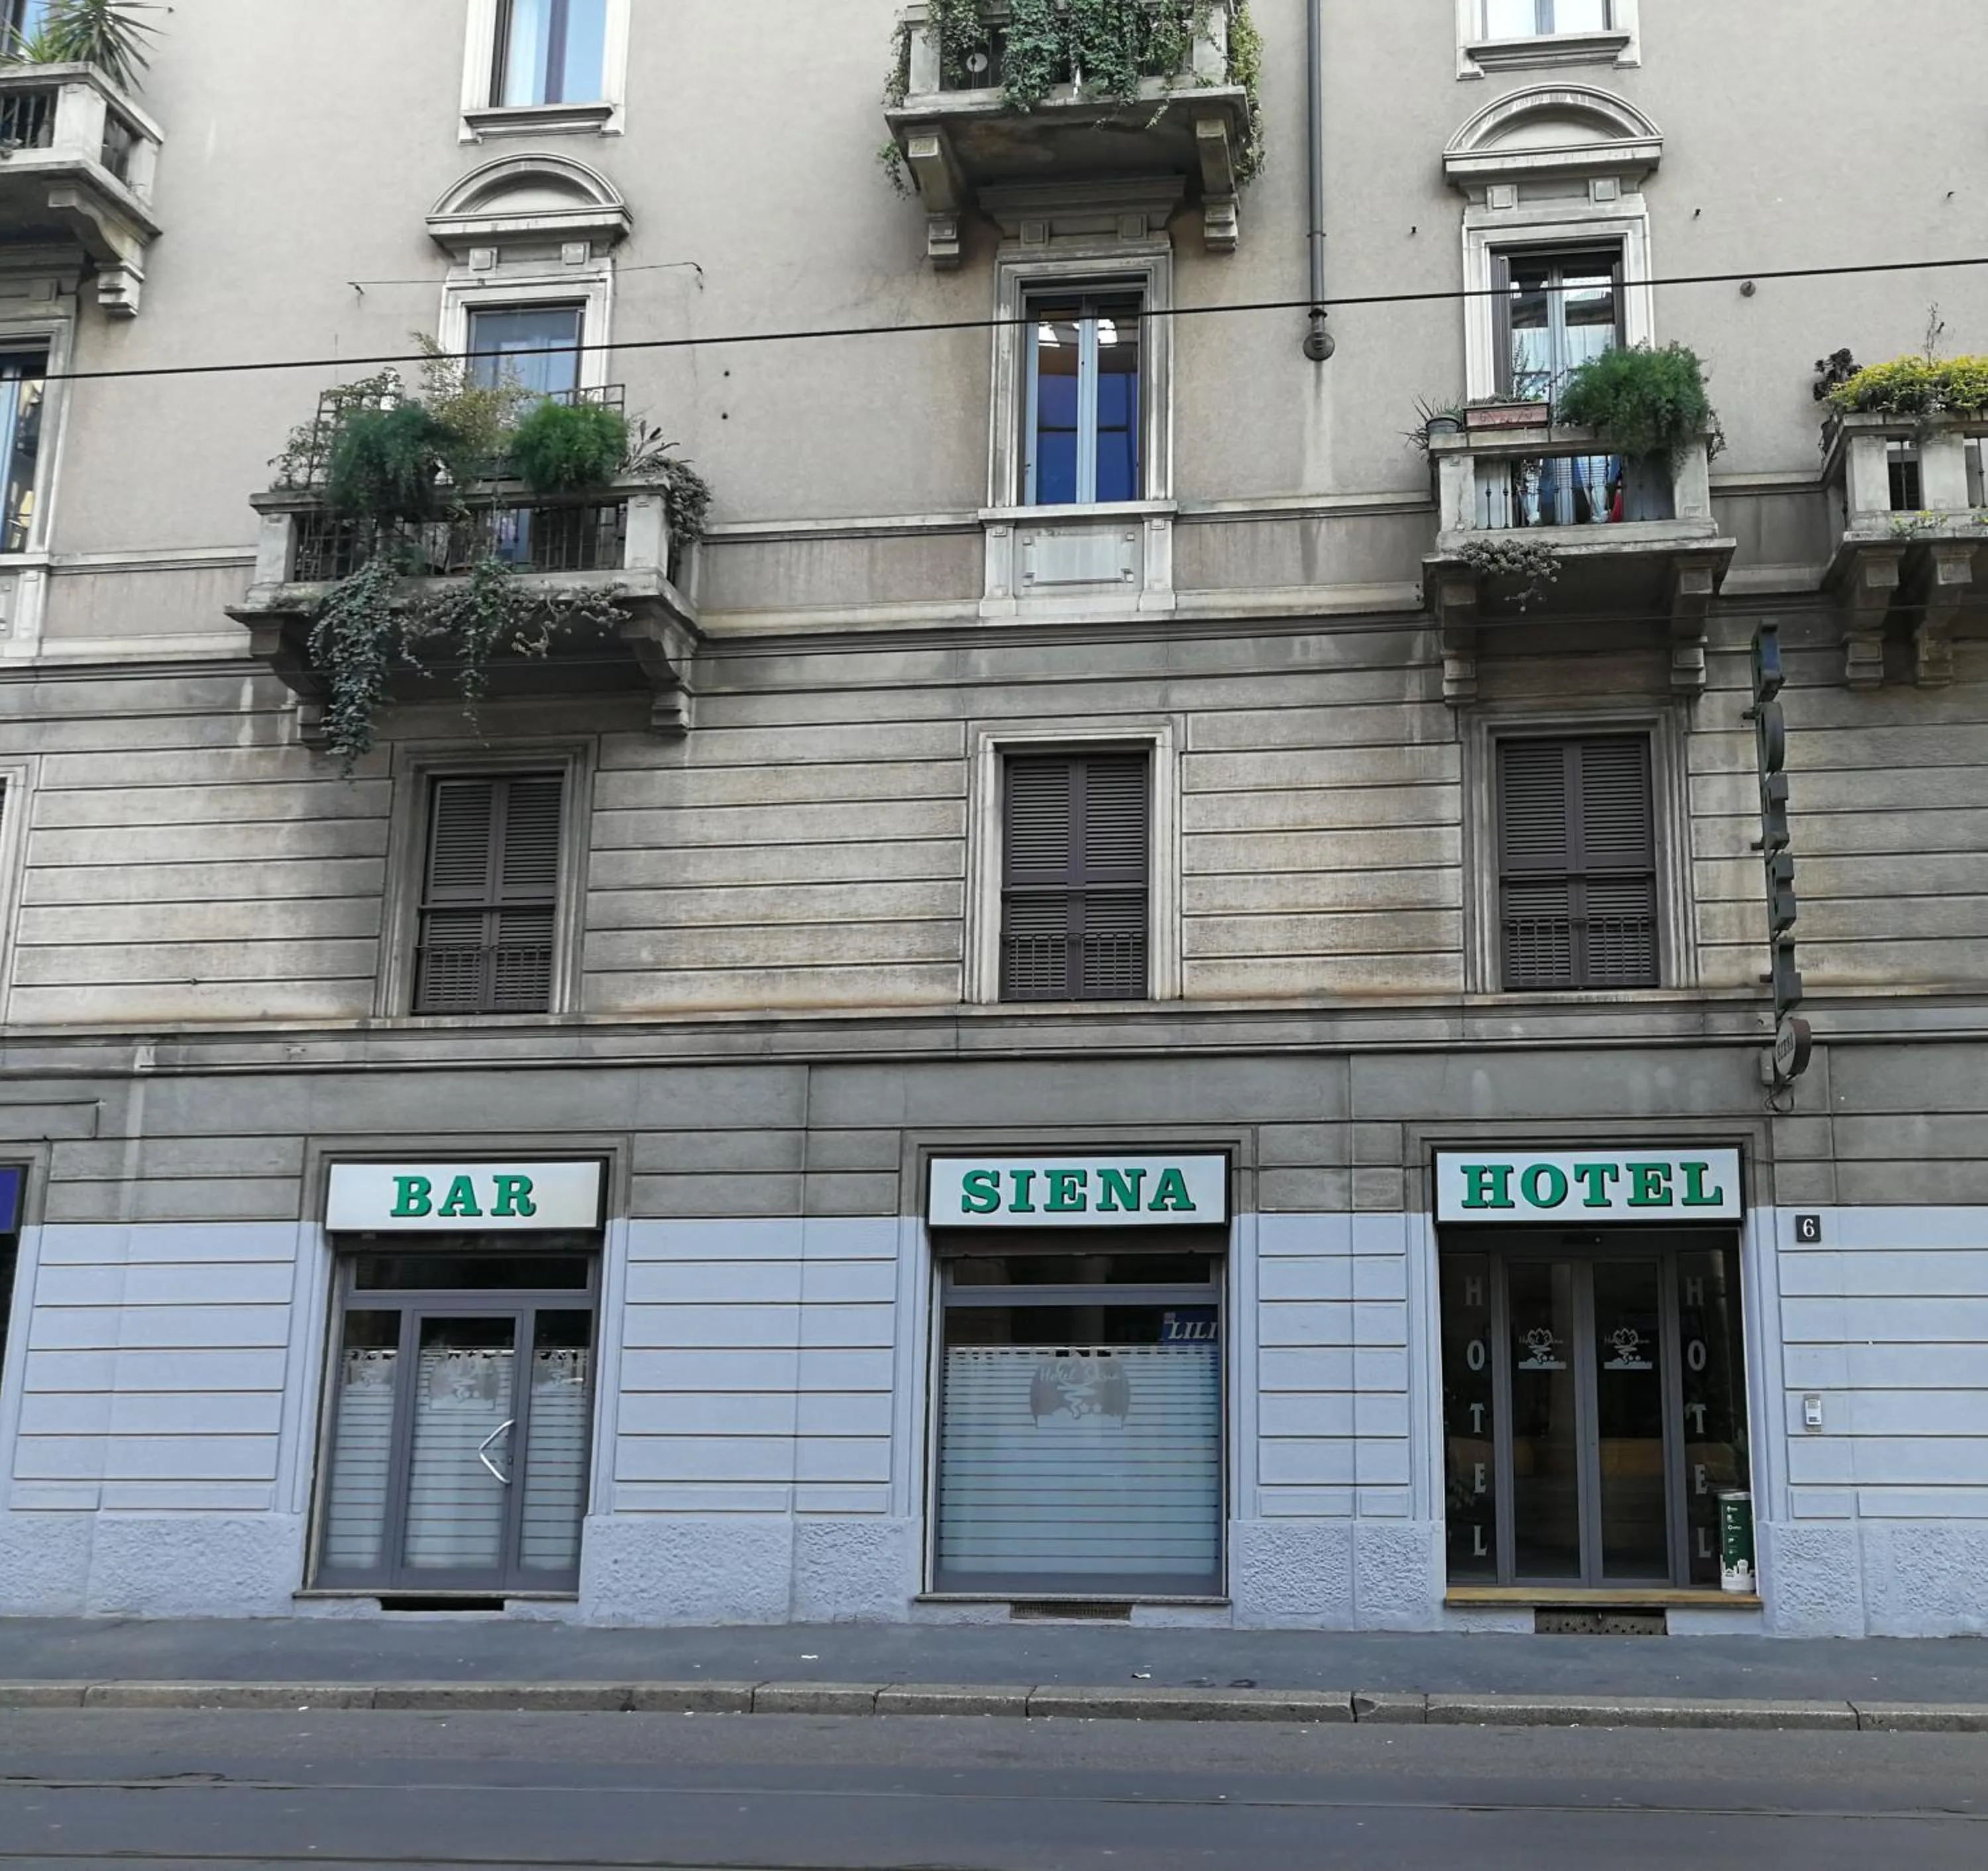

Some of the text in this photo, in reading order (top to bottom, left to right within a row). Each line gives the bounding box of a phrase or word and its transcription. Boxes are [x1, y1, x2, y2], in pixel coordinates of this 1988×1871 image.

[390, 1175, 537, 1217] BAR
[961, 1168, 1197, 1214] SIENA
[1460, 1161, 1724, 1209] HOTEL
[1802, 1218, 1815, 1238] 6
[1464, 1276, 1487, 1556] HOTEL
[1686, 1276, 1712, 1558] HOTEL
